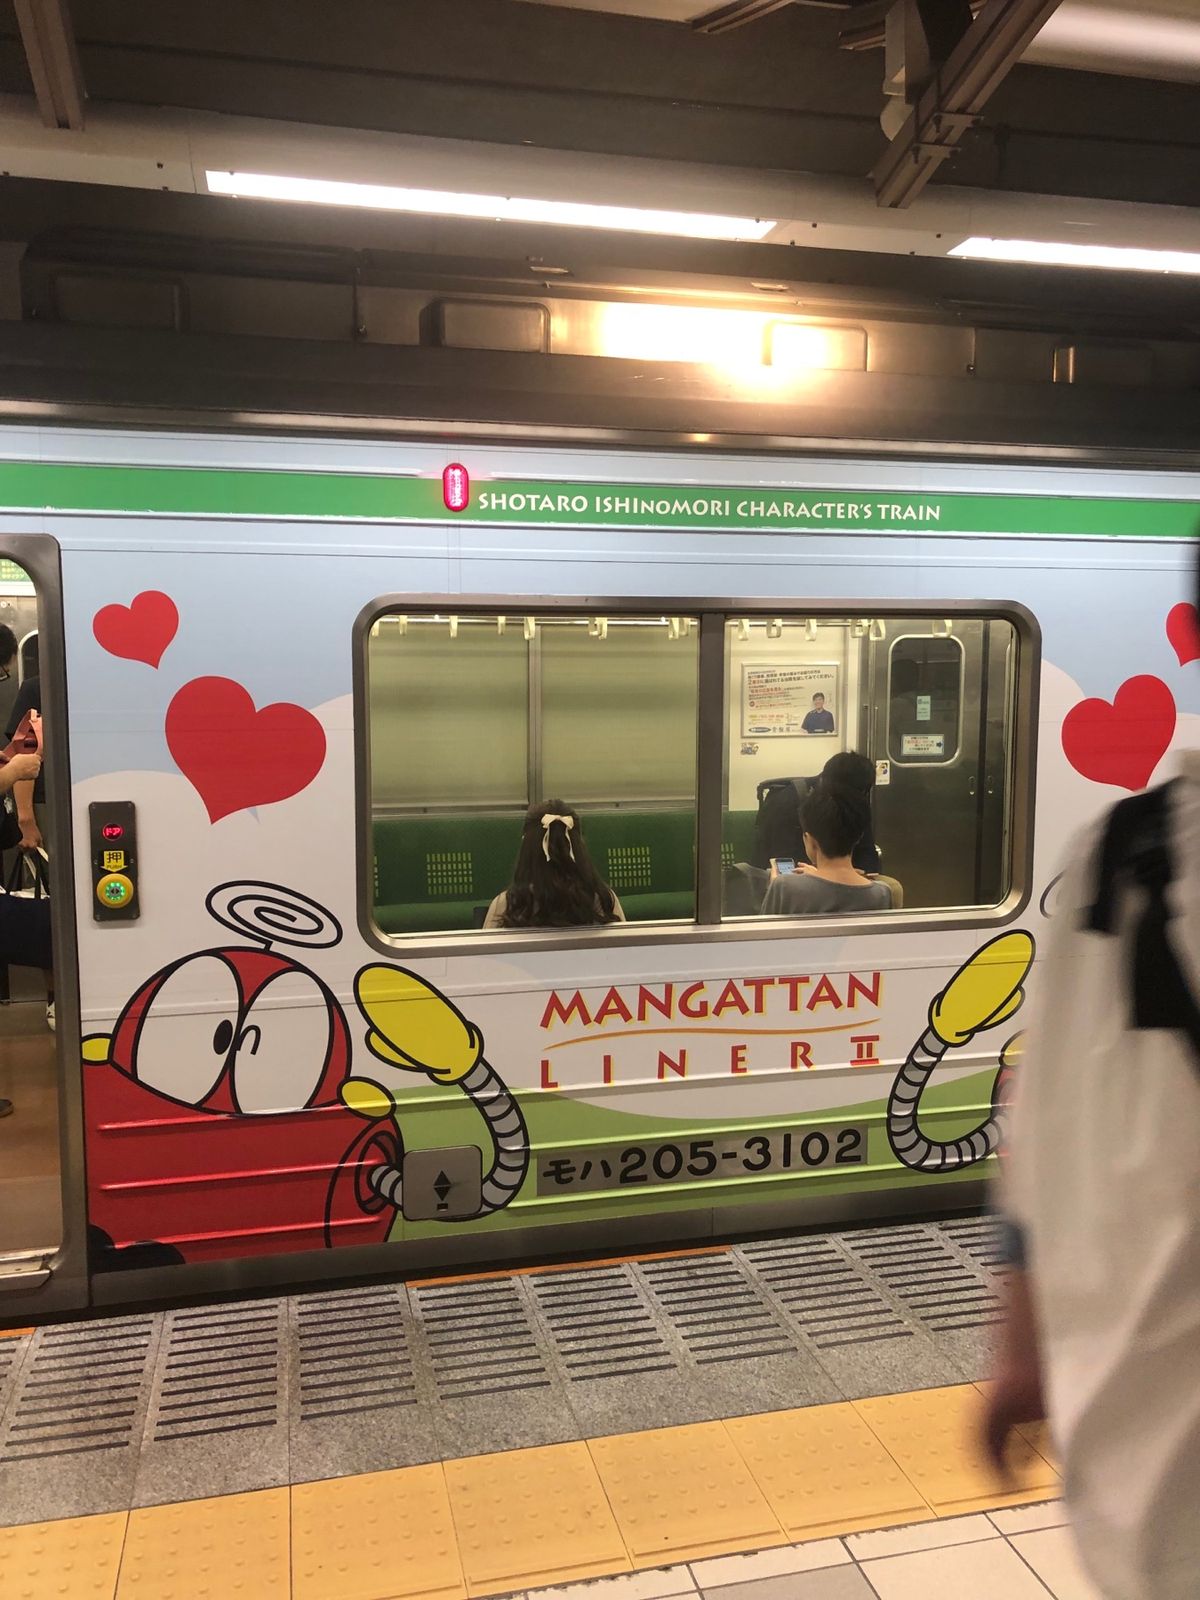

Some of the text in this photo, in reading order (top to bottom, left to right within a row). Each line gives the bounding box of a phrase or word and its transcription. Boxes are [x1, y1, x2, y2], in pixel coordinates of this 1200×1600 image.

[478, 492, 941, 521] SHOTARO ISHINOMORI CHARACTER'S TRAIN
[105, 827, 120, 836] ドア
[106, 852, 122, 863] 押
[540, 972, 881, 1028] MANGATTAN
[540, 1041, 814, 1089] LINER
[543, 1129, 862, 1185] モハ205-3102
